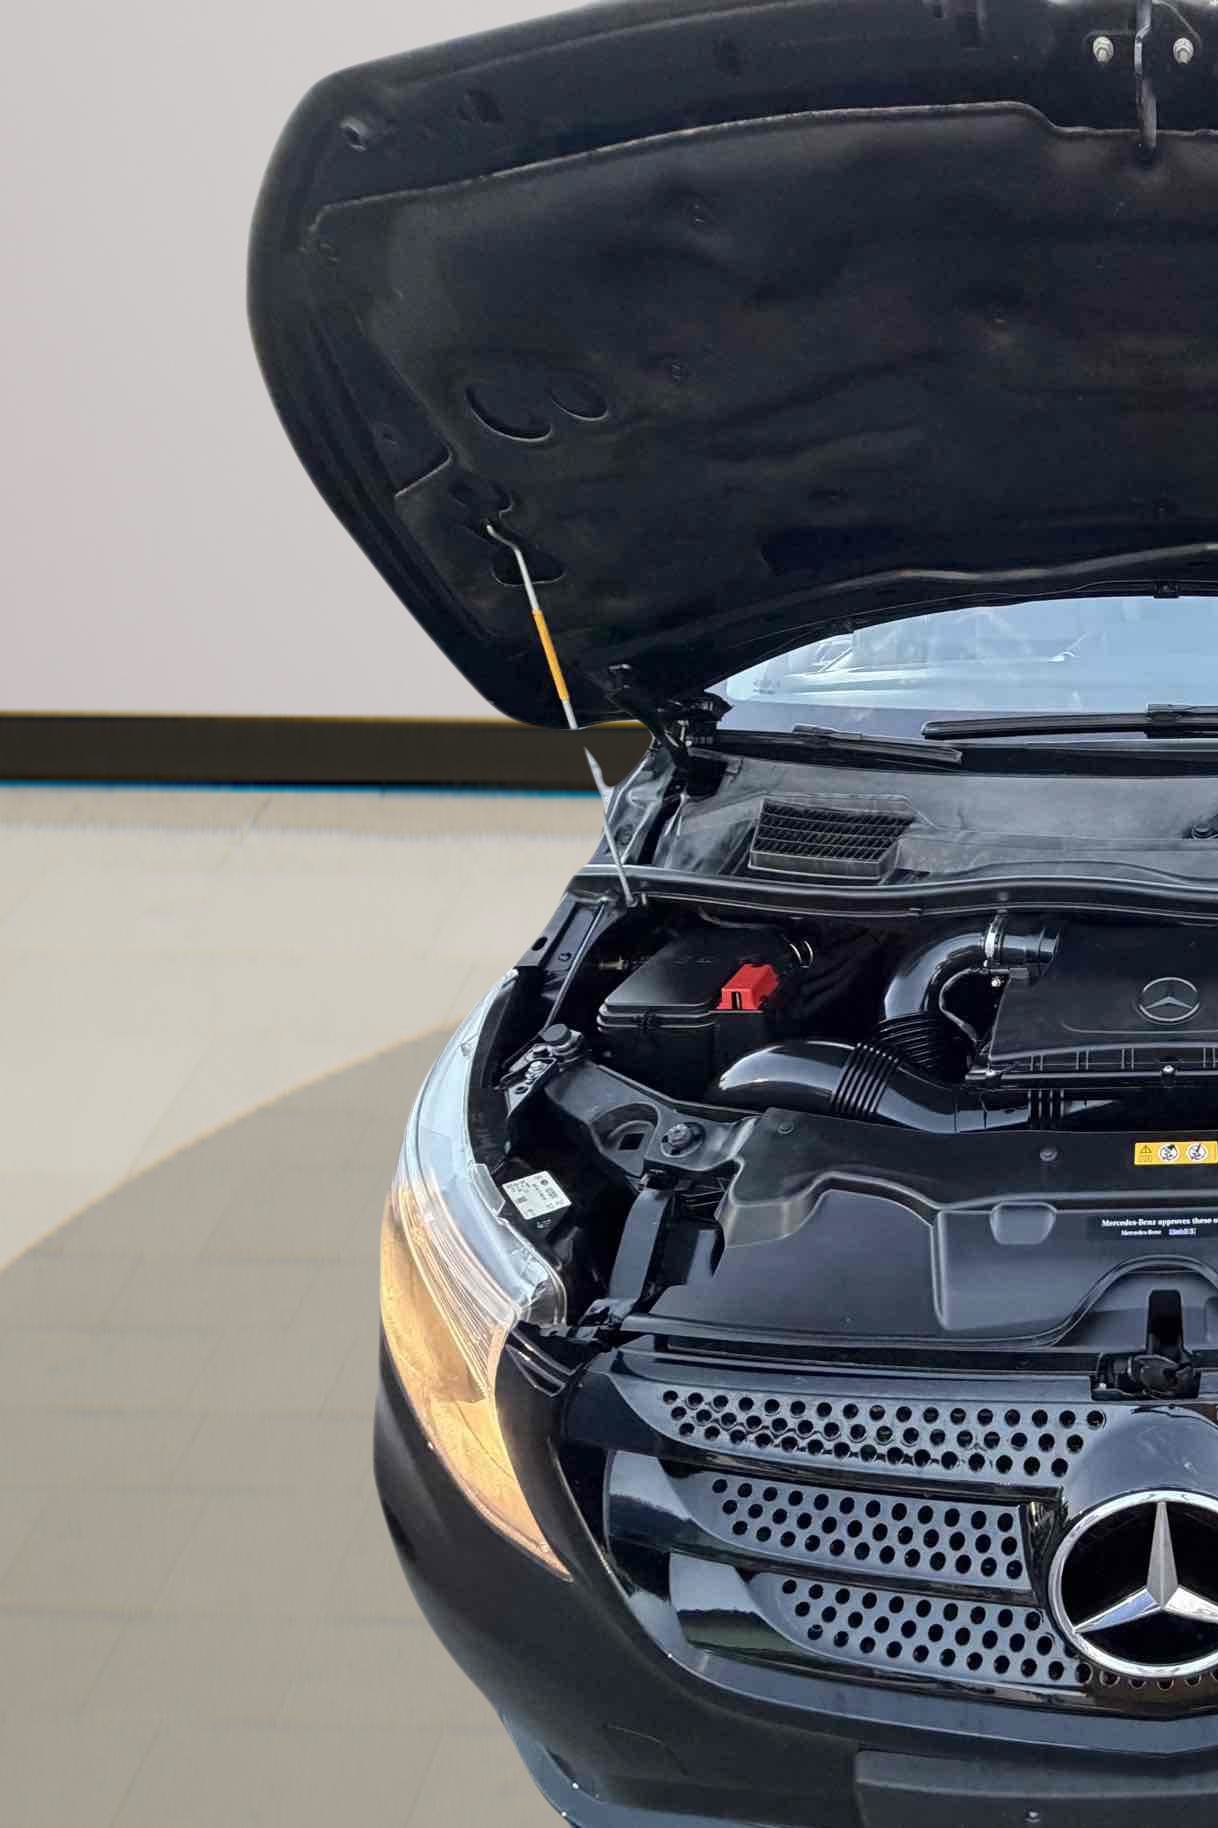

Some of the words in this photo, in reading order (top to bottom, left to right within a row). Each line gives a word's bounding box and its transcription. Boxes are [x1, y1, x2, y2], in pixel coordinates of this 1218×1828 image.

[1101, 1218, 1156, 1227] Mercedes-Benz
[1158, 1218, 1190, 1227] approves
[1191, 1216, 1212, 1225] these
